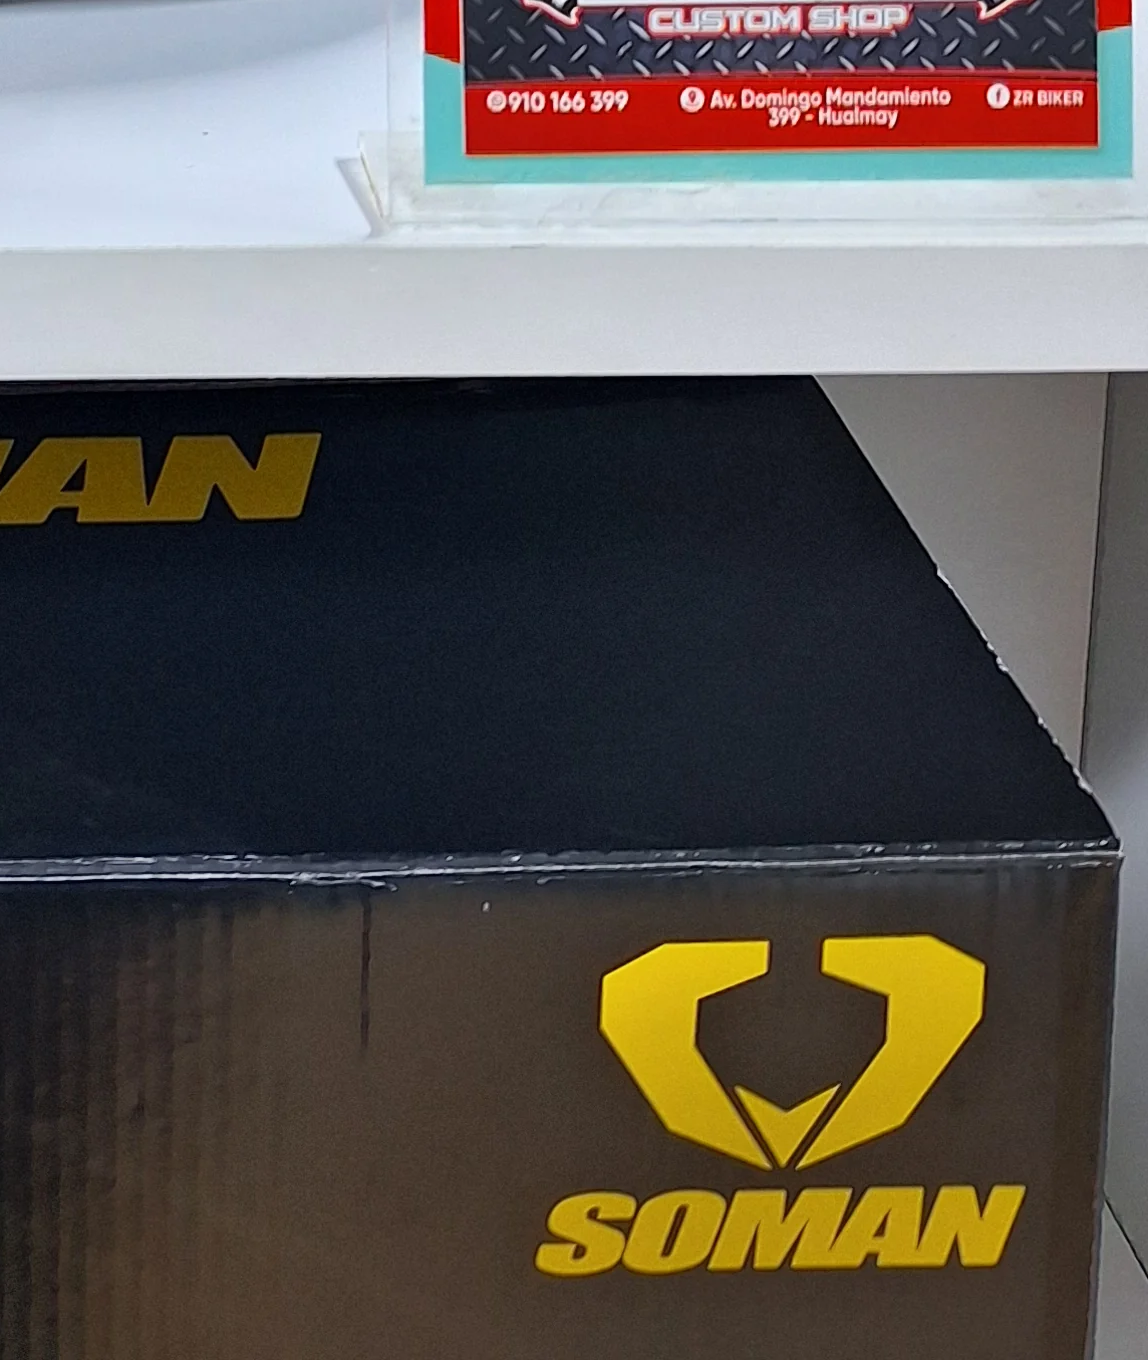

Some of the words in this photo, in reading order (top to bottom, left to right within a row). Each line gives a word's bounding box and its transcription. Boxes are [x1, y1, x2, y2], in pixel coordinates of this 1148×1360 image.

[648, 6, 802, 34] CUSTOM
[807, 4, 908, 30] SHOP
[508, 91, 545, 113] 910
[550, 91, 585, 112] 166
[590, 90, 628, 112] 399
[710, 89, 737, 110] Av.
[741, 87, 822, 112] Domingo
[825, 87, 951, 107] Mandamiento
[1013, 90, 1033, 107] ZR
[1037, 89, 1084, 106] BIKER
[768, 107, 800, 128] 399
[818, 106, 898, 129] Hualmay
[534, 1185, 1027, 1276] SOMAN
